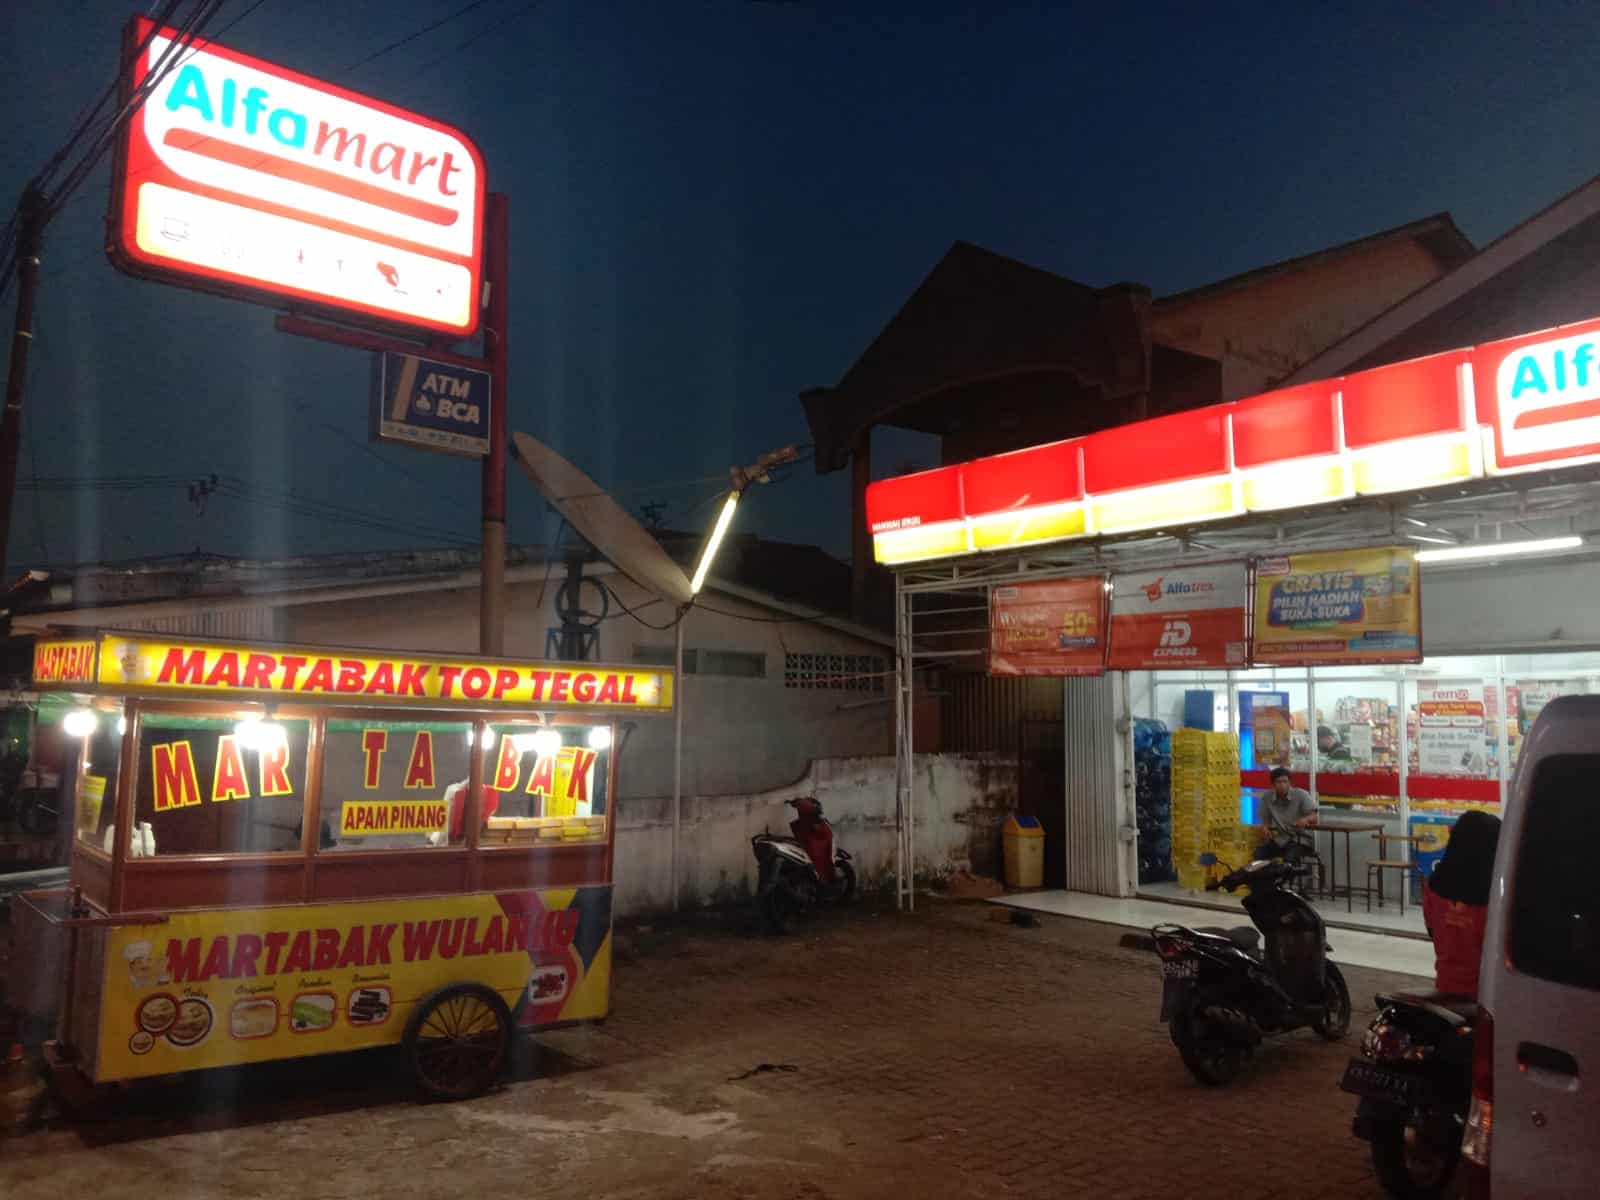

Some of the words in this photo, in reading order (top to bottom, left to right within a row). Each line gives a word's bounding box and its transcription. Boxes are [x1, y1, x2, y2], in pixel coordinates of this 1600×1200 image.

[165, 63, 464, 197] Alfamart
[422, 373, 471, 399] ATM
[1511, 343, 1600, 399] Alf
[437, 397, 480, 424] BCA
[36, 643, 94, 681] MARTABAK
[157, 647, 431, 697] MARTABAK
[438, 665, 520, 700] TOP
[530, 671, 638, 704] TEGAL
[344, 806, 387, 831] APAM
[391, 804, 447, 828] PINANG
[165, 922, 399, 983] MARTABAK
